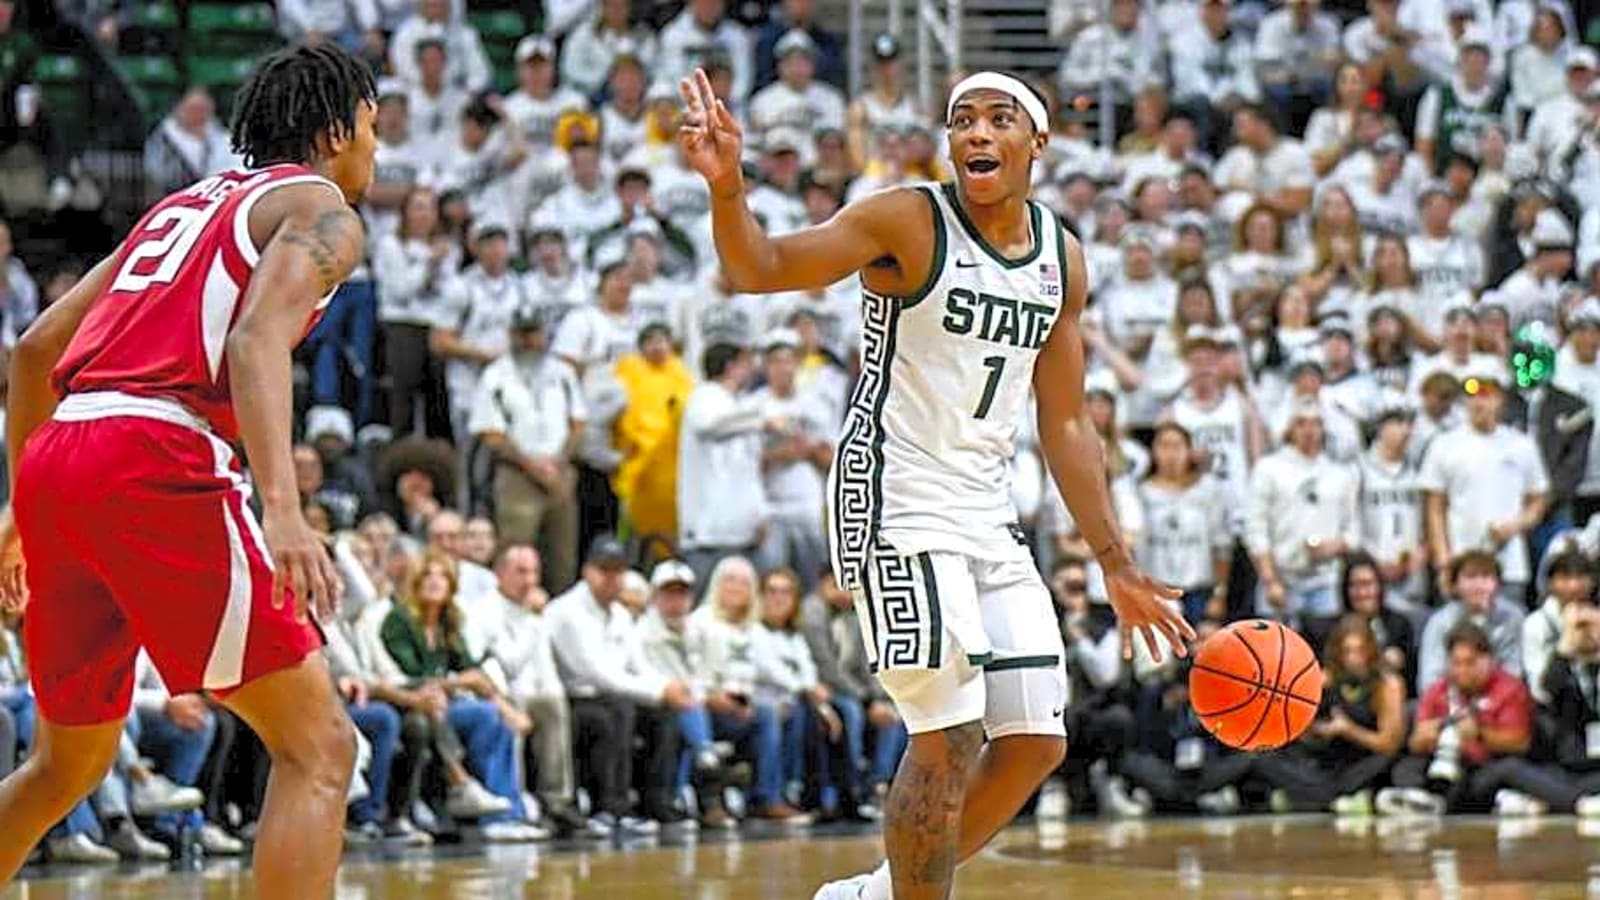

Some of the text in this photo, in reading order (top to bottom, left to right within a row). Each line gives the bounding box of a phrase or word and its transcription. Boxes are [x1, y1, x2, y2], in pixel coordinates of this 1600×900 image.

[110, 203, 221, 293] 21
[943, 287, 1056, 349] STATE
[973, 355, 1006, 419] 1
